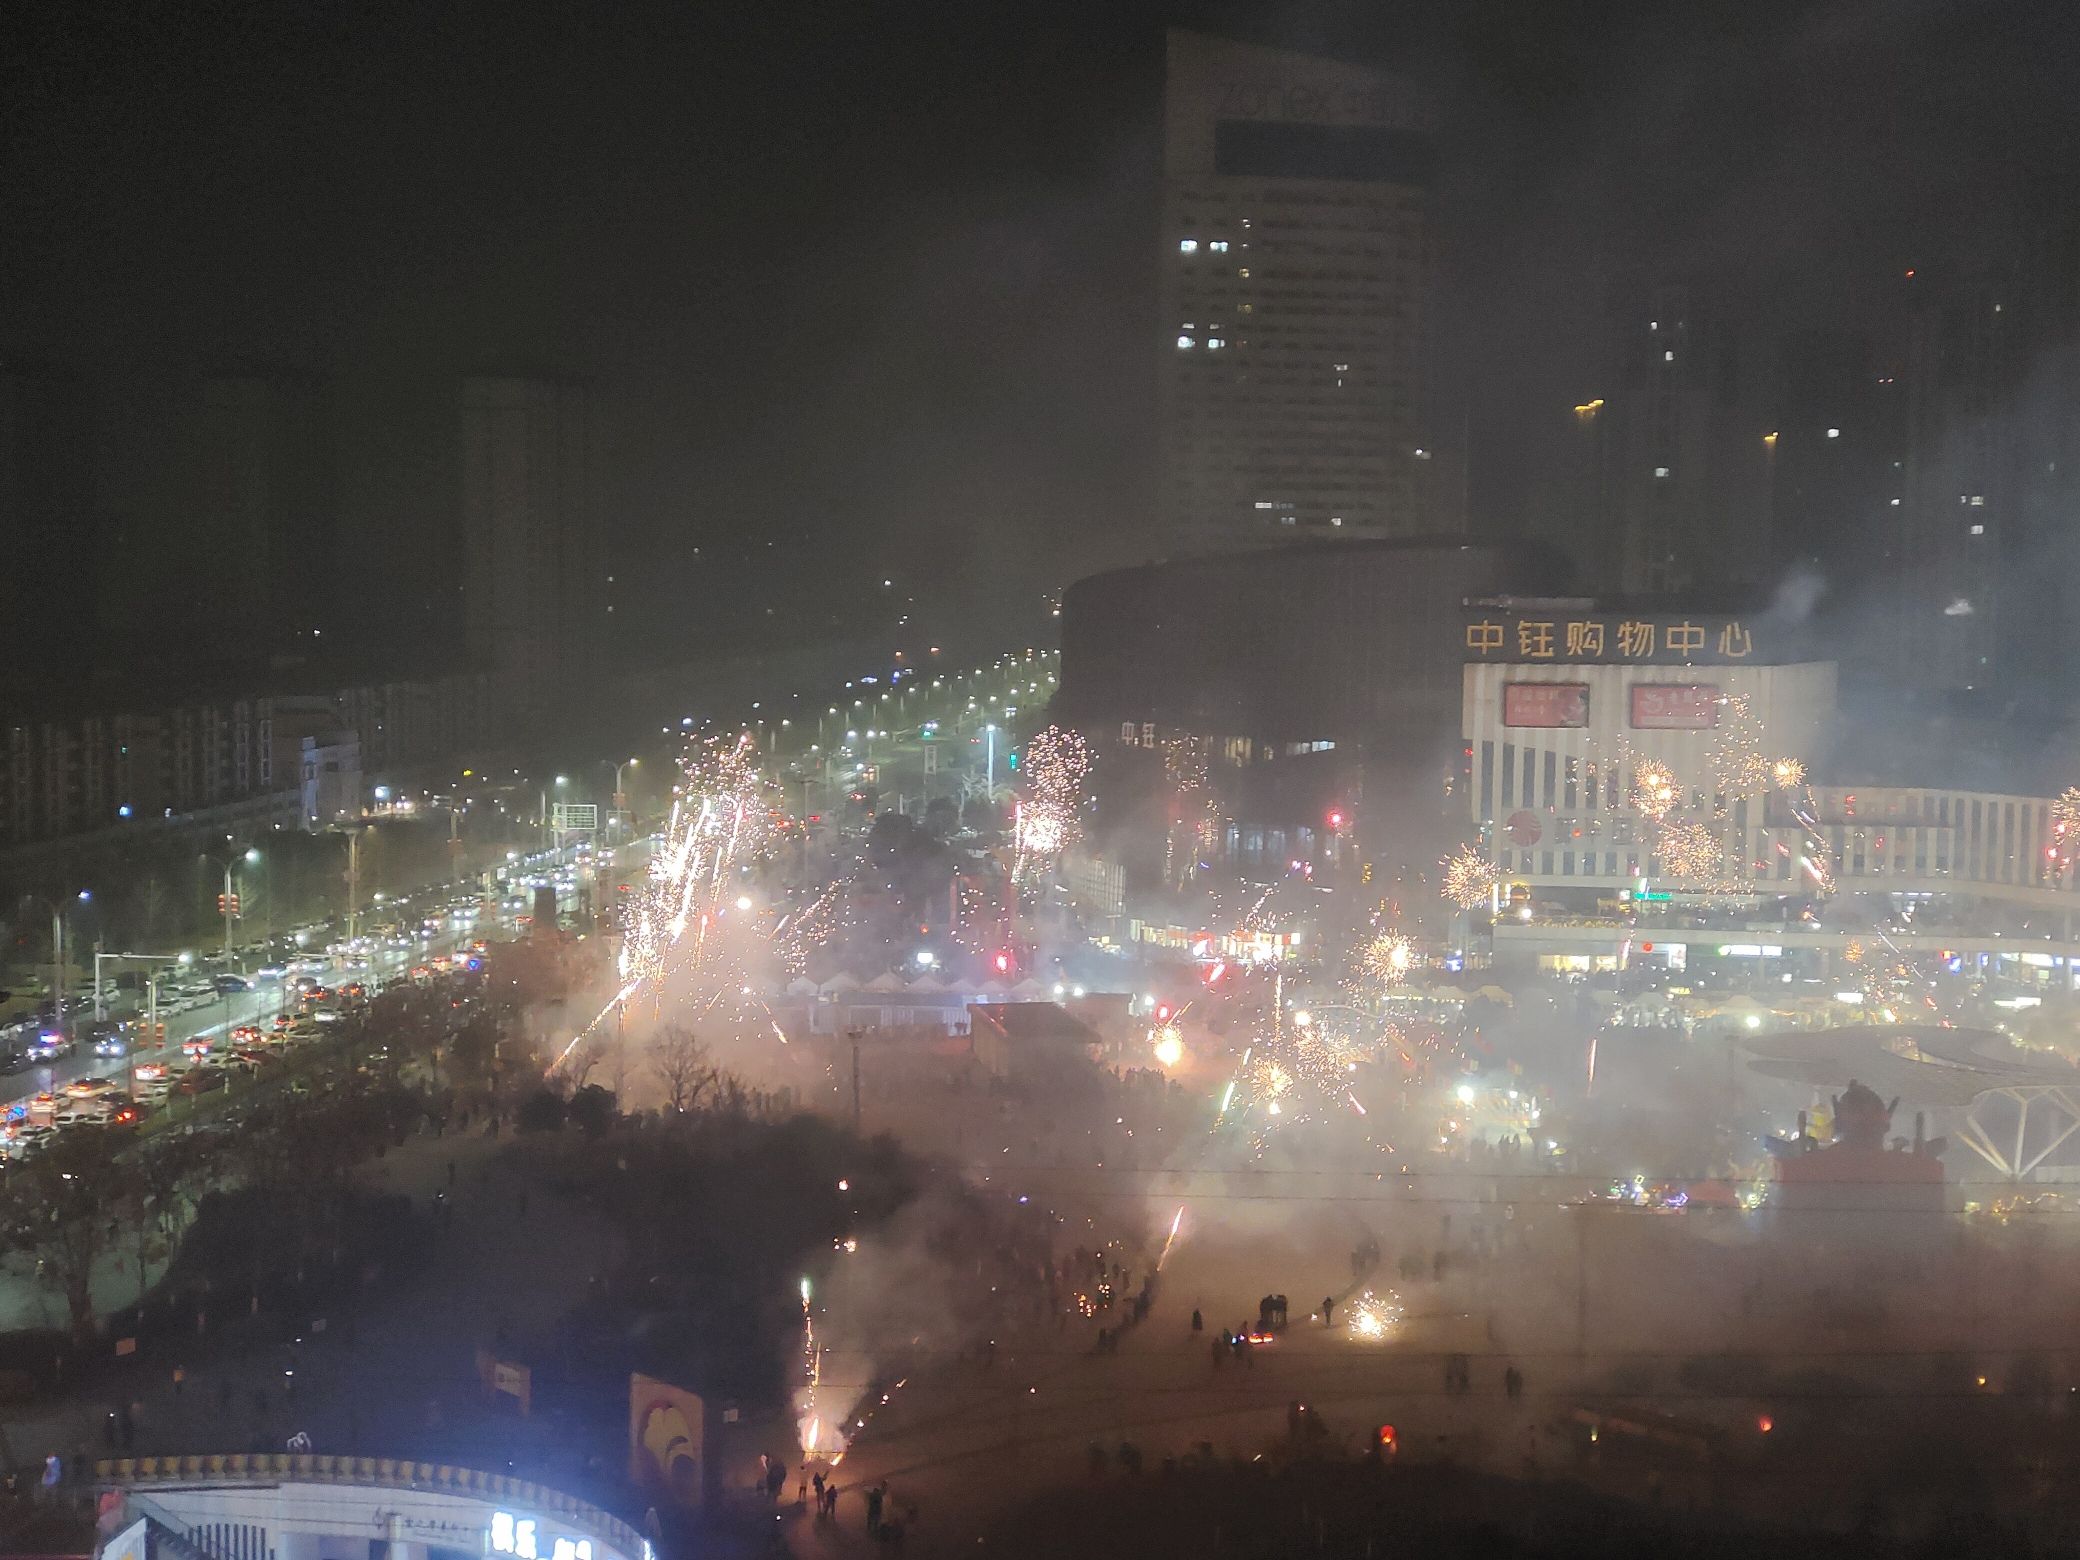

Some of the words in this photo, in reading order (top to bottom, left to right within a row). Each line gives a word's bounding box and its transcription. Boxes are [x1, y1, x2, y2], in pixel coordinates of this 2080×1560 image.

[1465, 620, 1752, 658] 中钰购物中心
